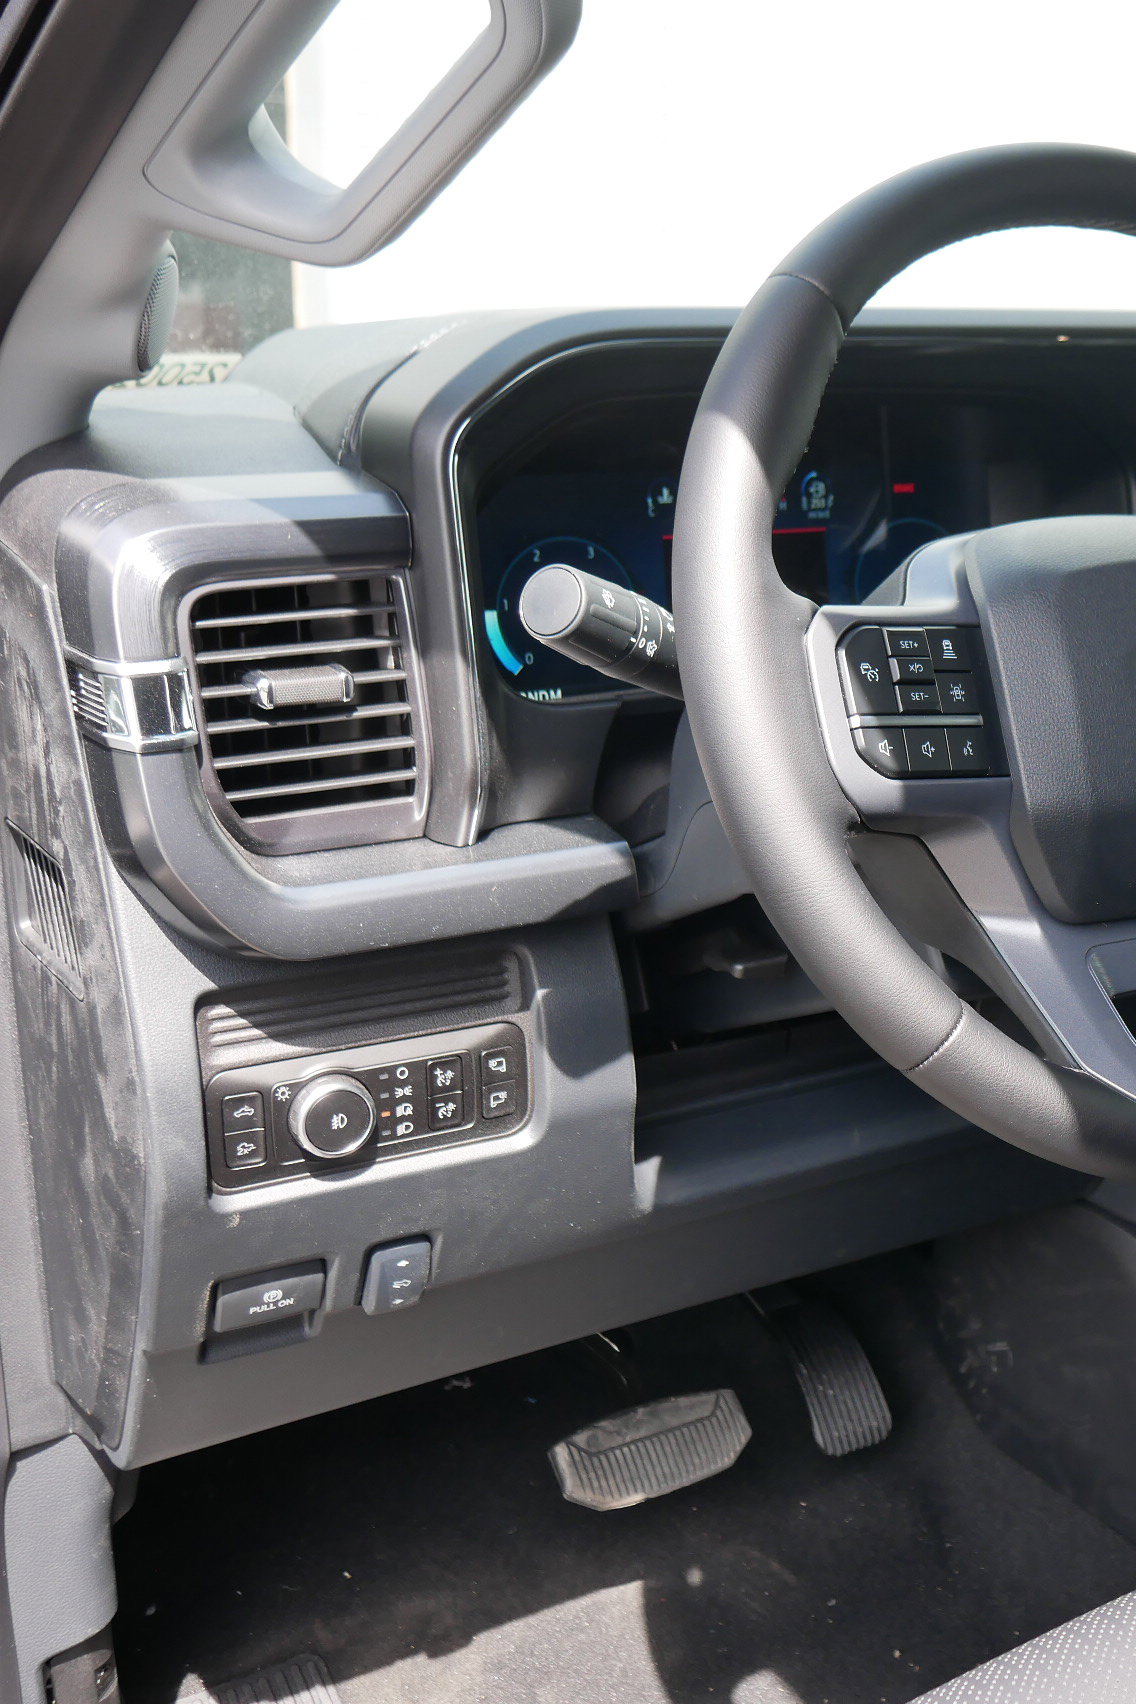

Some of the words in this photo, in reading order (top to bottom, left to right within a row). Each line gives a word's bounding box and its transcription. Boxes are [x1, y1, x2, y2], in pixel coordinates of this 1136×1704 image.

[532, 549, 541, 562] 2
[900, 640, 919, 649] SET+
[910, 692, 930, 701] SET-
[249, 1303, 276, 1315] PULL
[278, 1297, 295, 1308] ON
